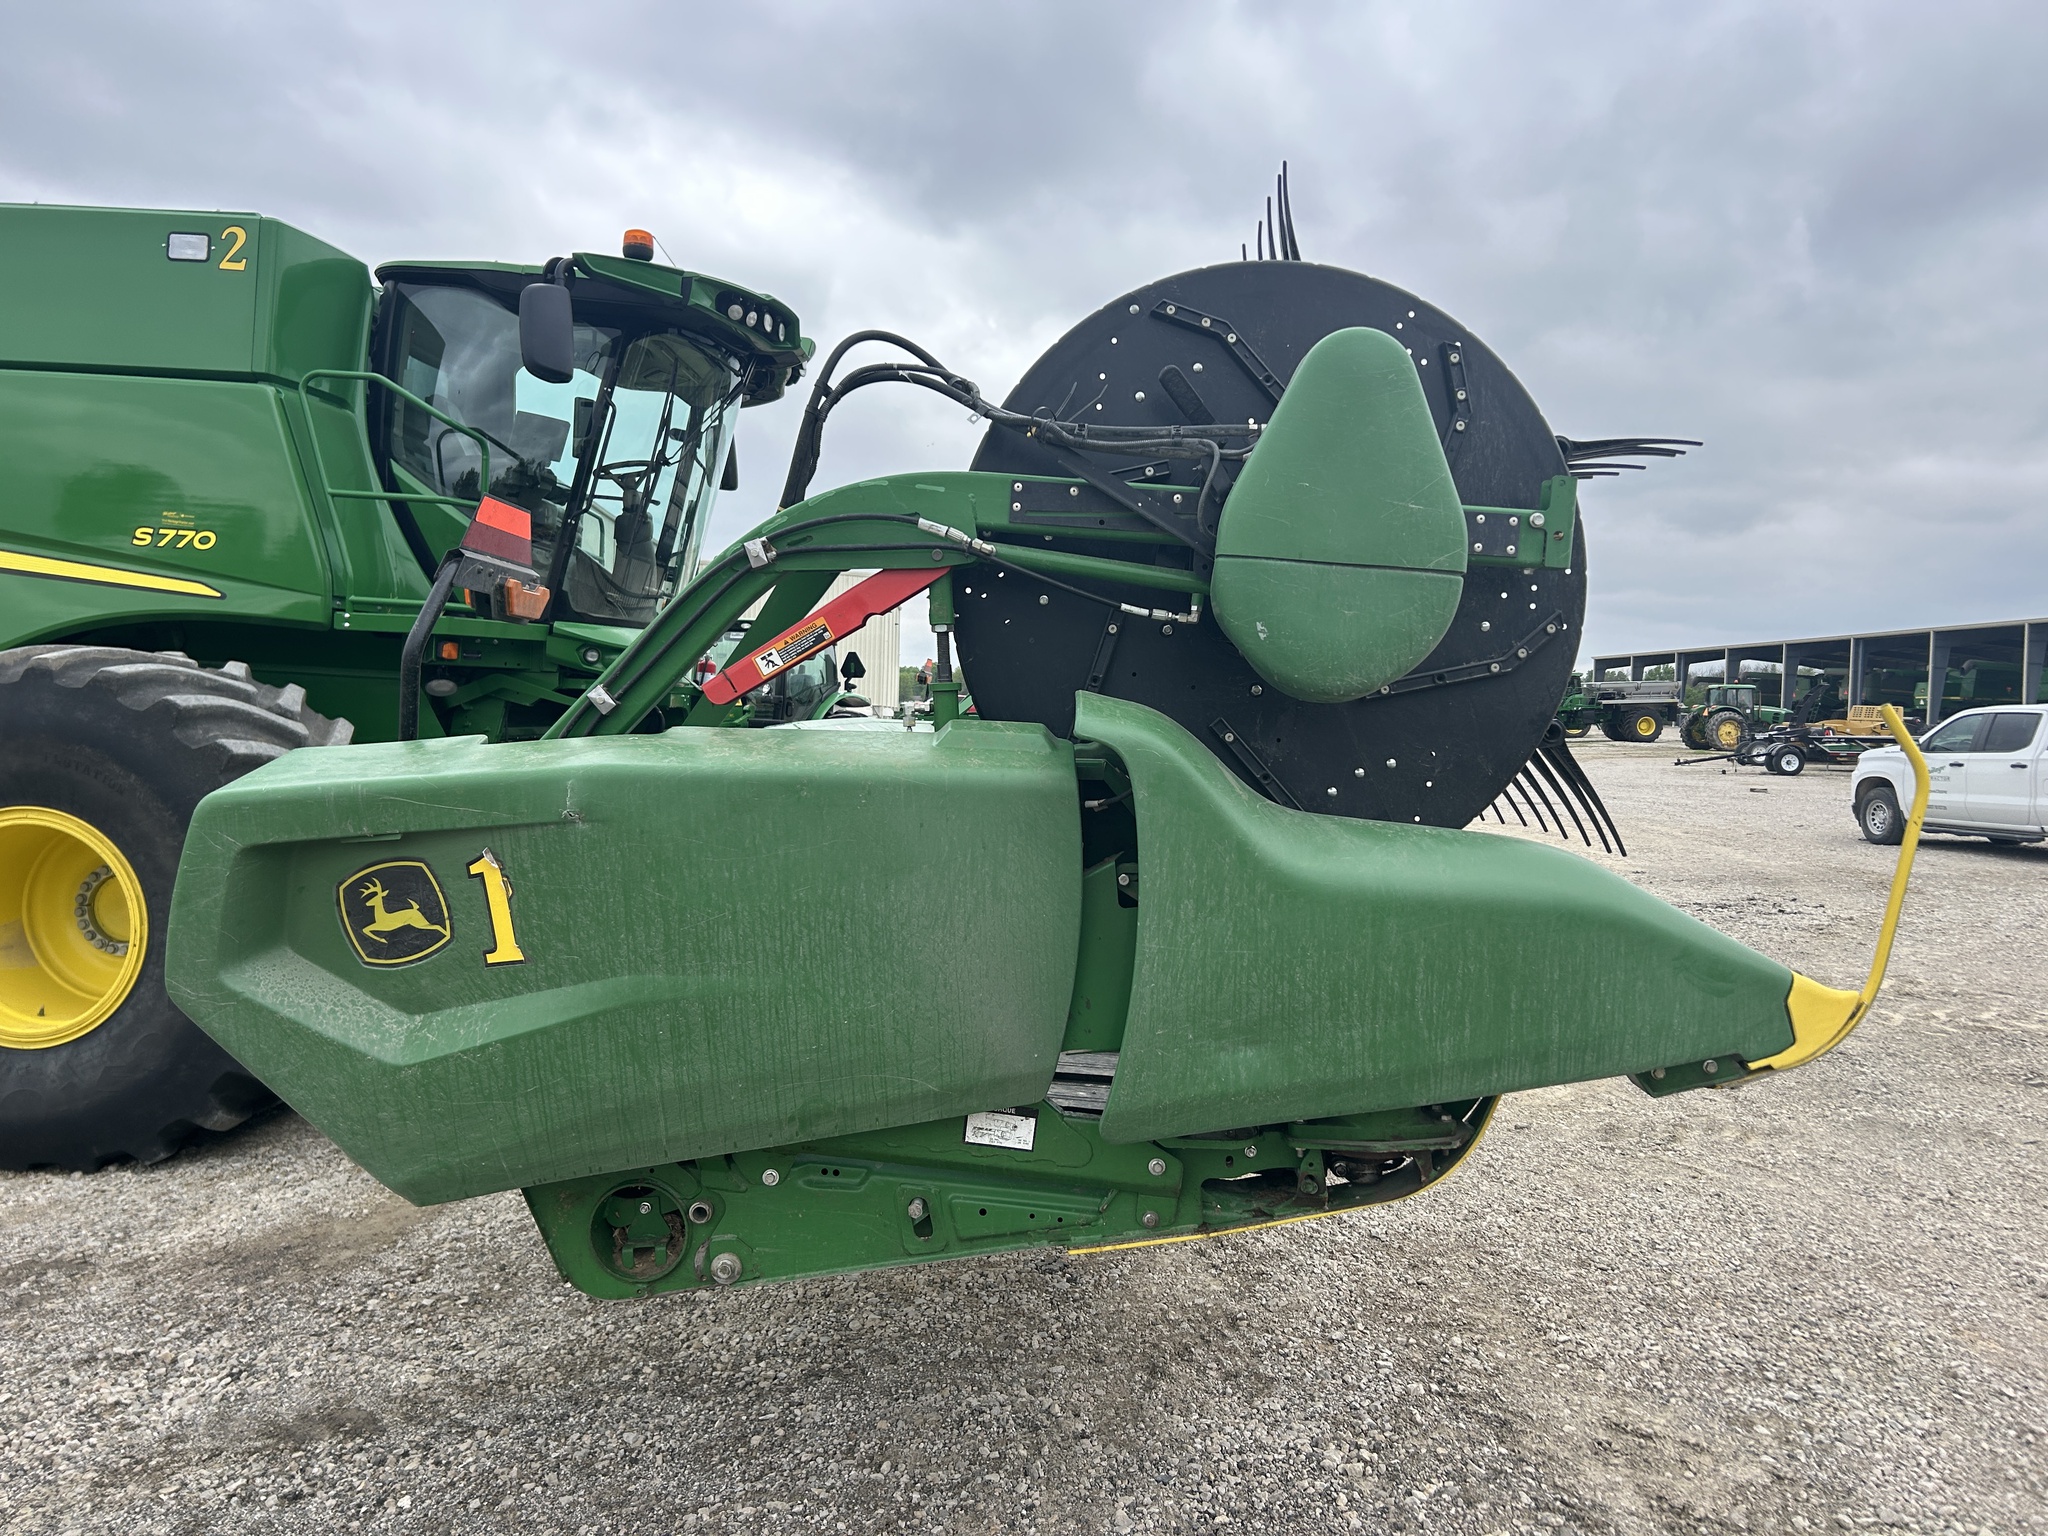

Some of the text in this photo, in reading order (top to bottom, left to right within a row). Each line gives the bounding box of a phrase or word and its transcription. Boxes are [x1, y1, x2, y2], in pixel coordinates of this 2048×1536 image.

[217, 225, 249, 272] 2
[131, 525, 218, 551] S770
[789, 622, 818, 641] WARNING
[466, 847, 526, 970] 1
